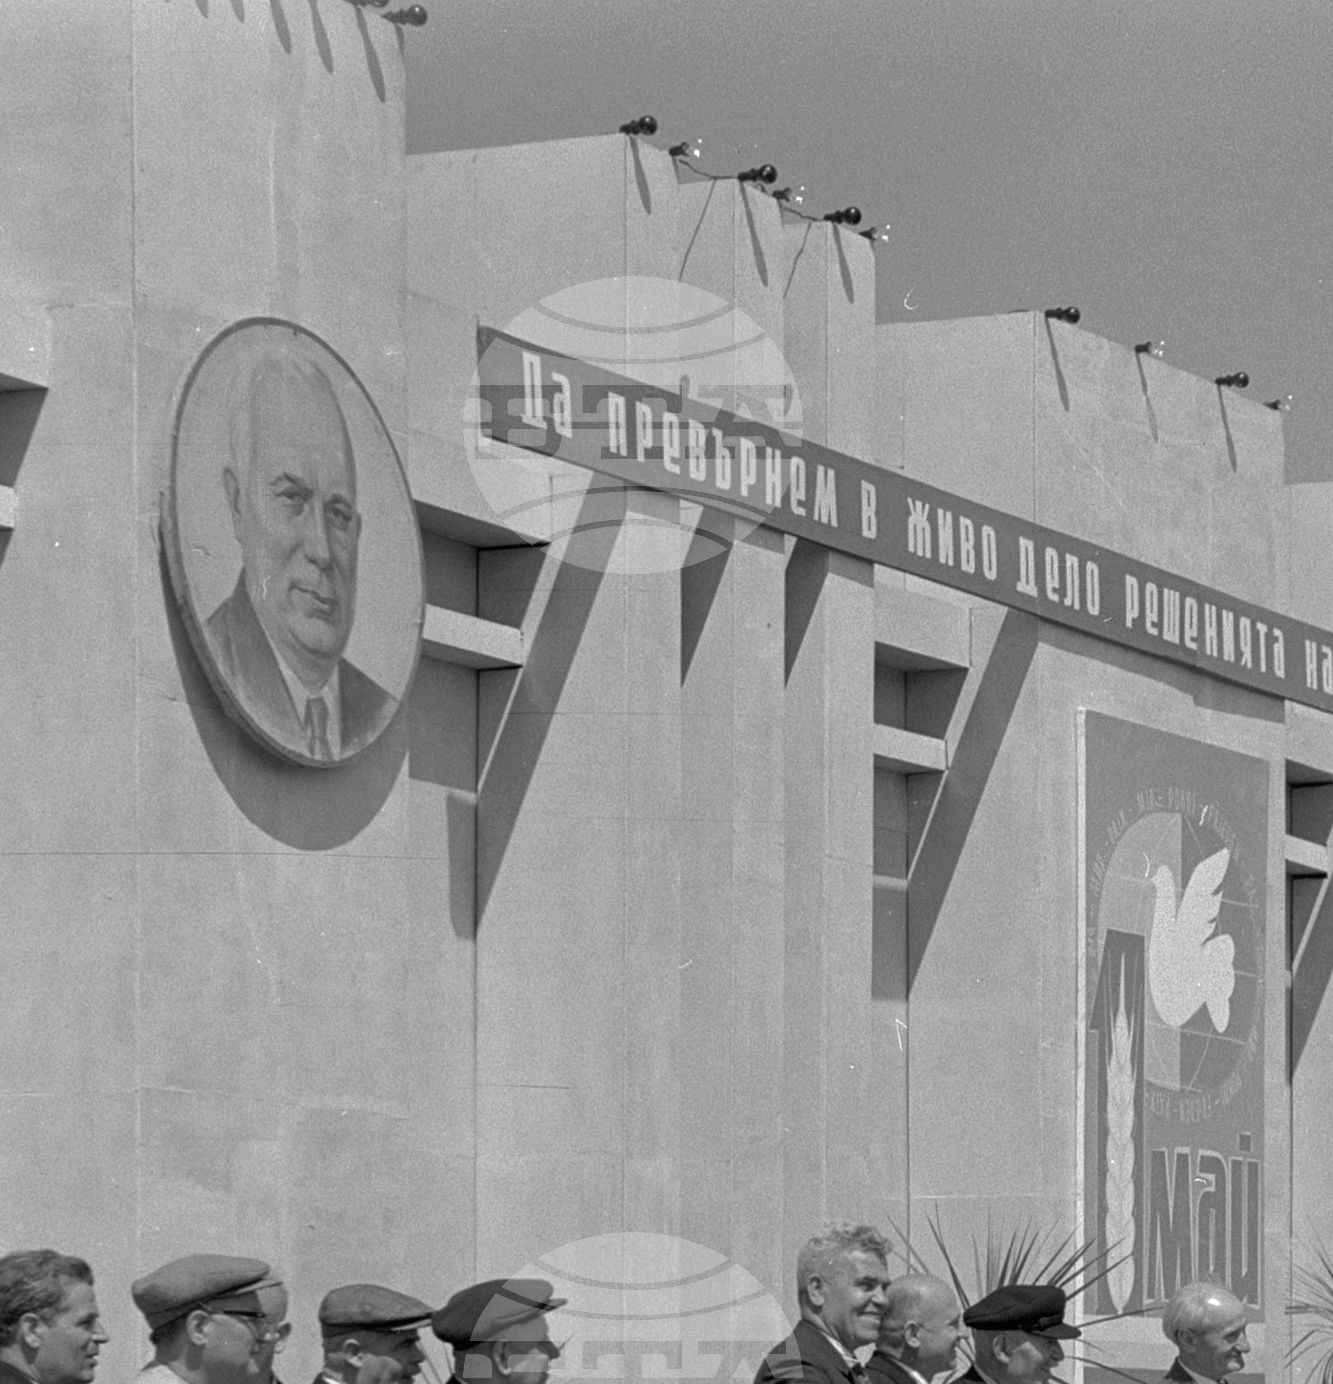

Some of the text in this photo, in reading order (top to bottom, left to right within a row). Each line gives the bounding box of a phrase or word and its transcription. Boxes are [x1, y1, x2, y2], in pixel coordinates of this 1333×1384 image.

[520, 350, 573, 438] Да
[606, 390, 840, 529] превърнем
[906, 496, 998, 581] живо
[1015, 538, 1102, 617] дело
[1124, 573, 1286, 680] решенията
